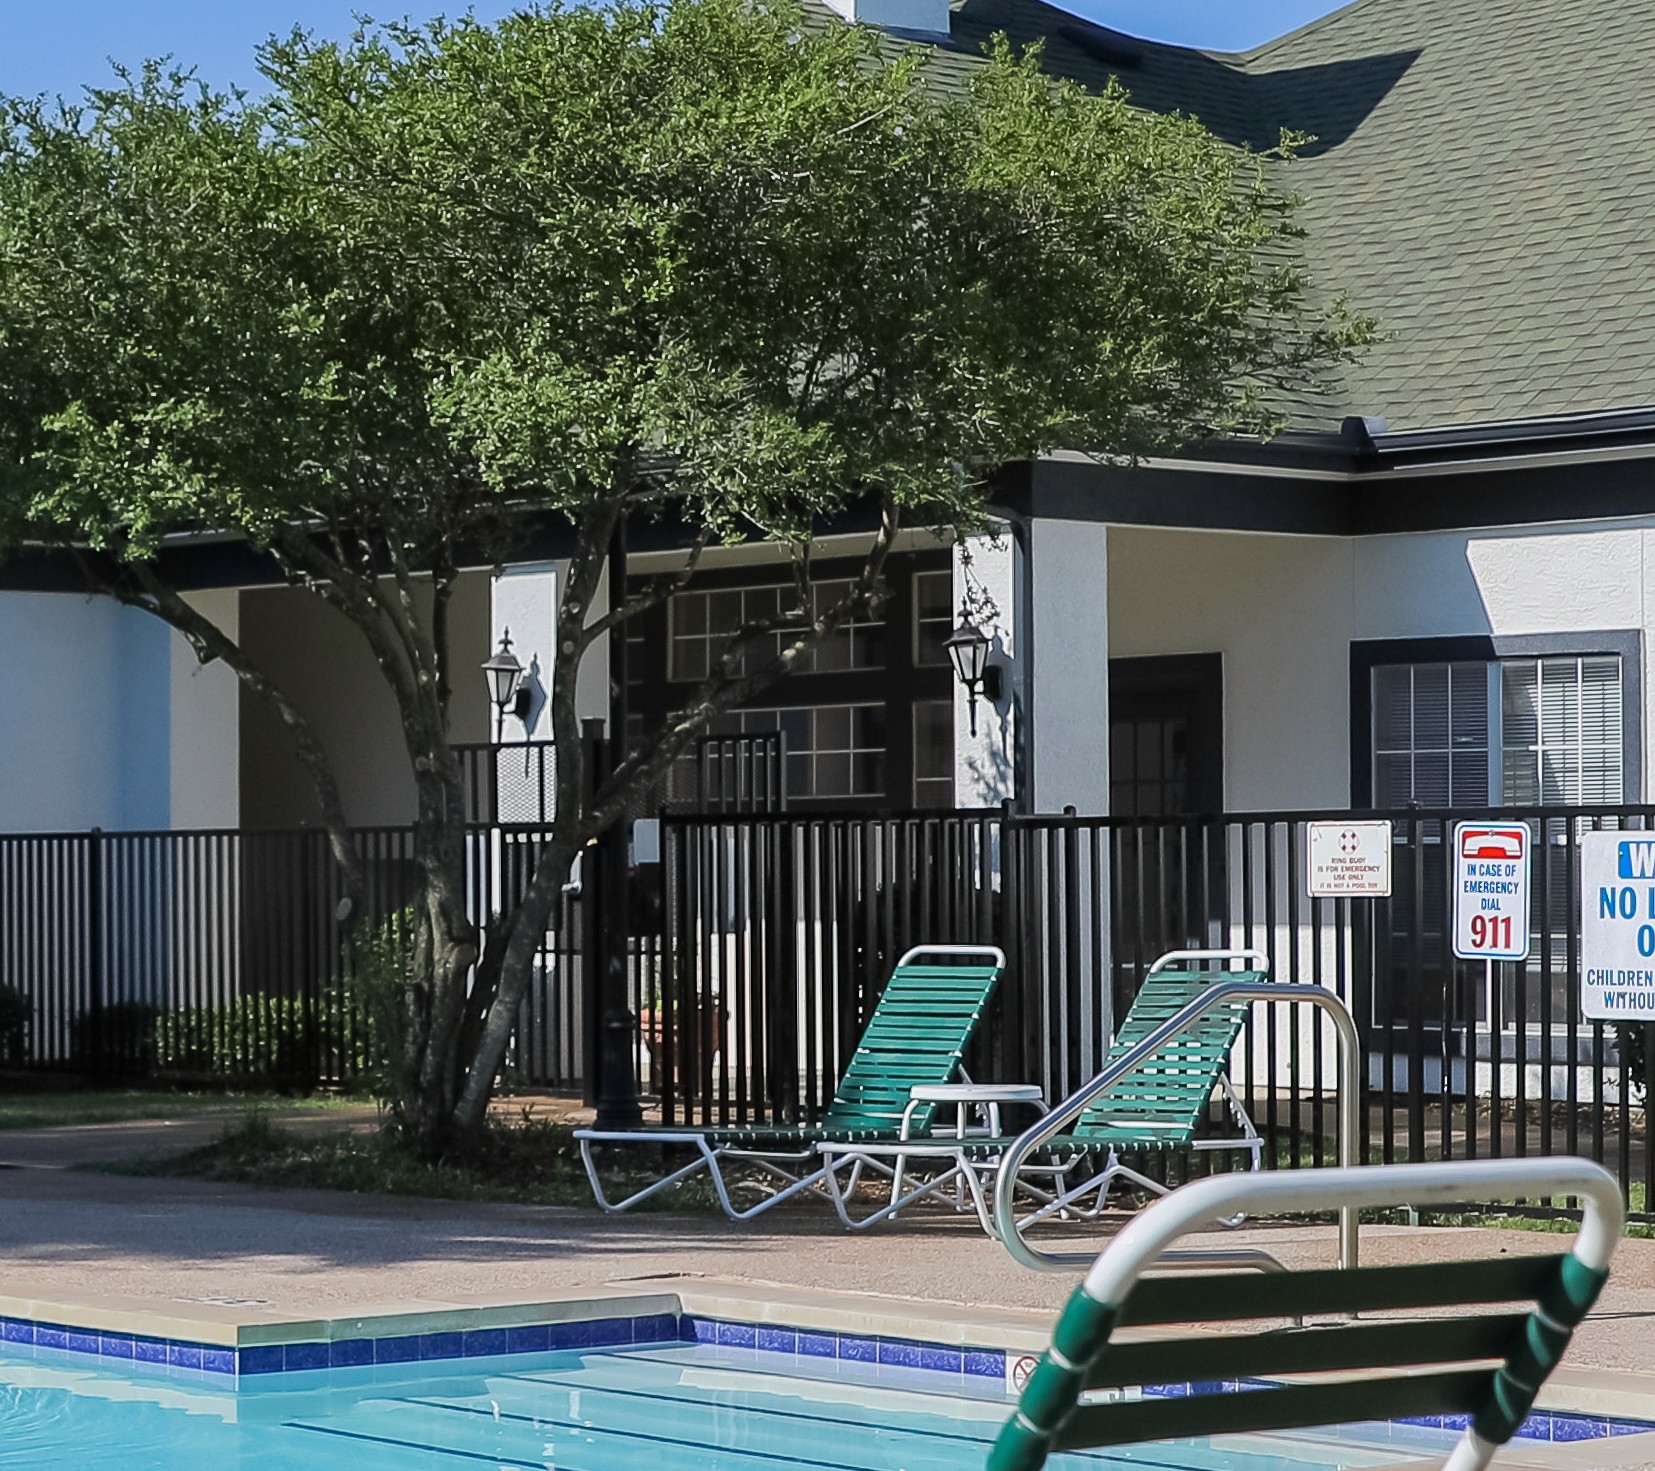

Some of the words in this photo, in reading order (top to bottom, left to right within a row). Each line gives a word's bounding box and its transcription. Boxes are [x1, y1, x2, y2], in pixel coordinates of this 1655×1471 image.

[1341, 865, 1381, 873] EMERGENCY
[1467, 863, 1477, 876] IN
[1478, 863, 1503, 877] CASE
[1505, 864, 1517, 877] OF
[1463, 880, 1520, 895] EMERGENCY
[1480, 898, 1501, 911] DIAL
[1599, 886, 1637, 919] NO
[1471, 915, 1511, 949] 911
[1586, 969, 1654, 987] CHILDREN
